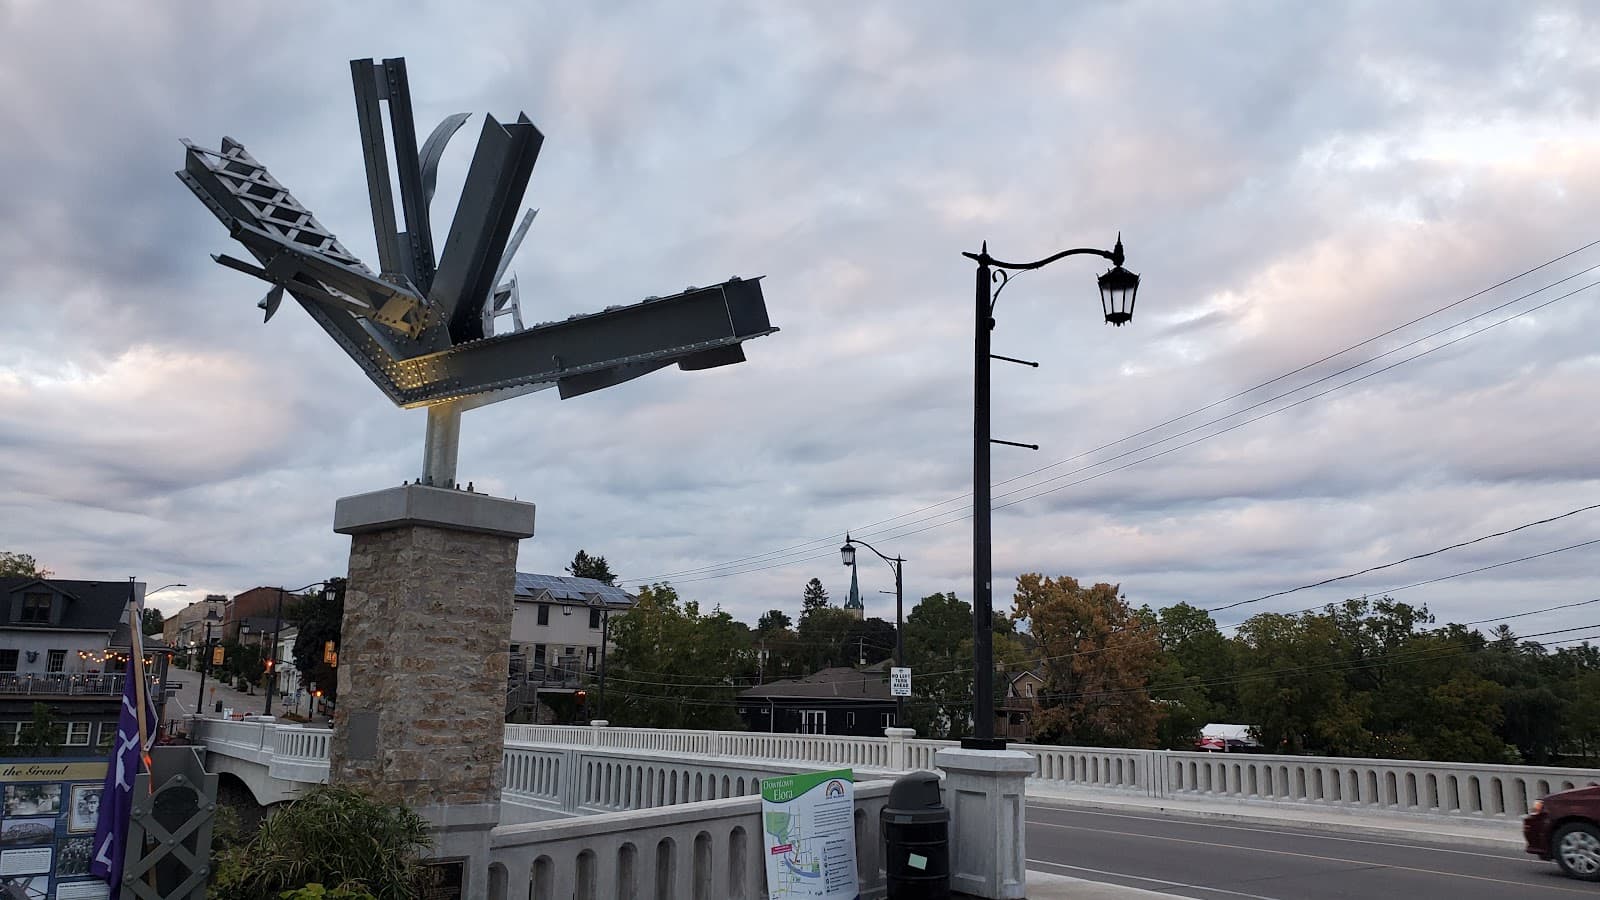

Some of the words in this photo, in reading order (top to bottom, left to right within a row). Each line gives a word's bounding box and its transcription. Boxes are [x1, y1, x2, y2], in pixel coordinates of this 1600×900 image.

[3, 766, 22, 776] the
[26, 765, 69, 776] Grand
[763, 780, 794, 790] Downtown
[773, 789, 793, 801] Elora
